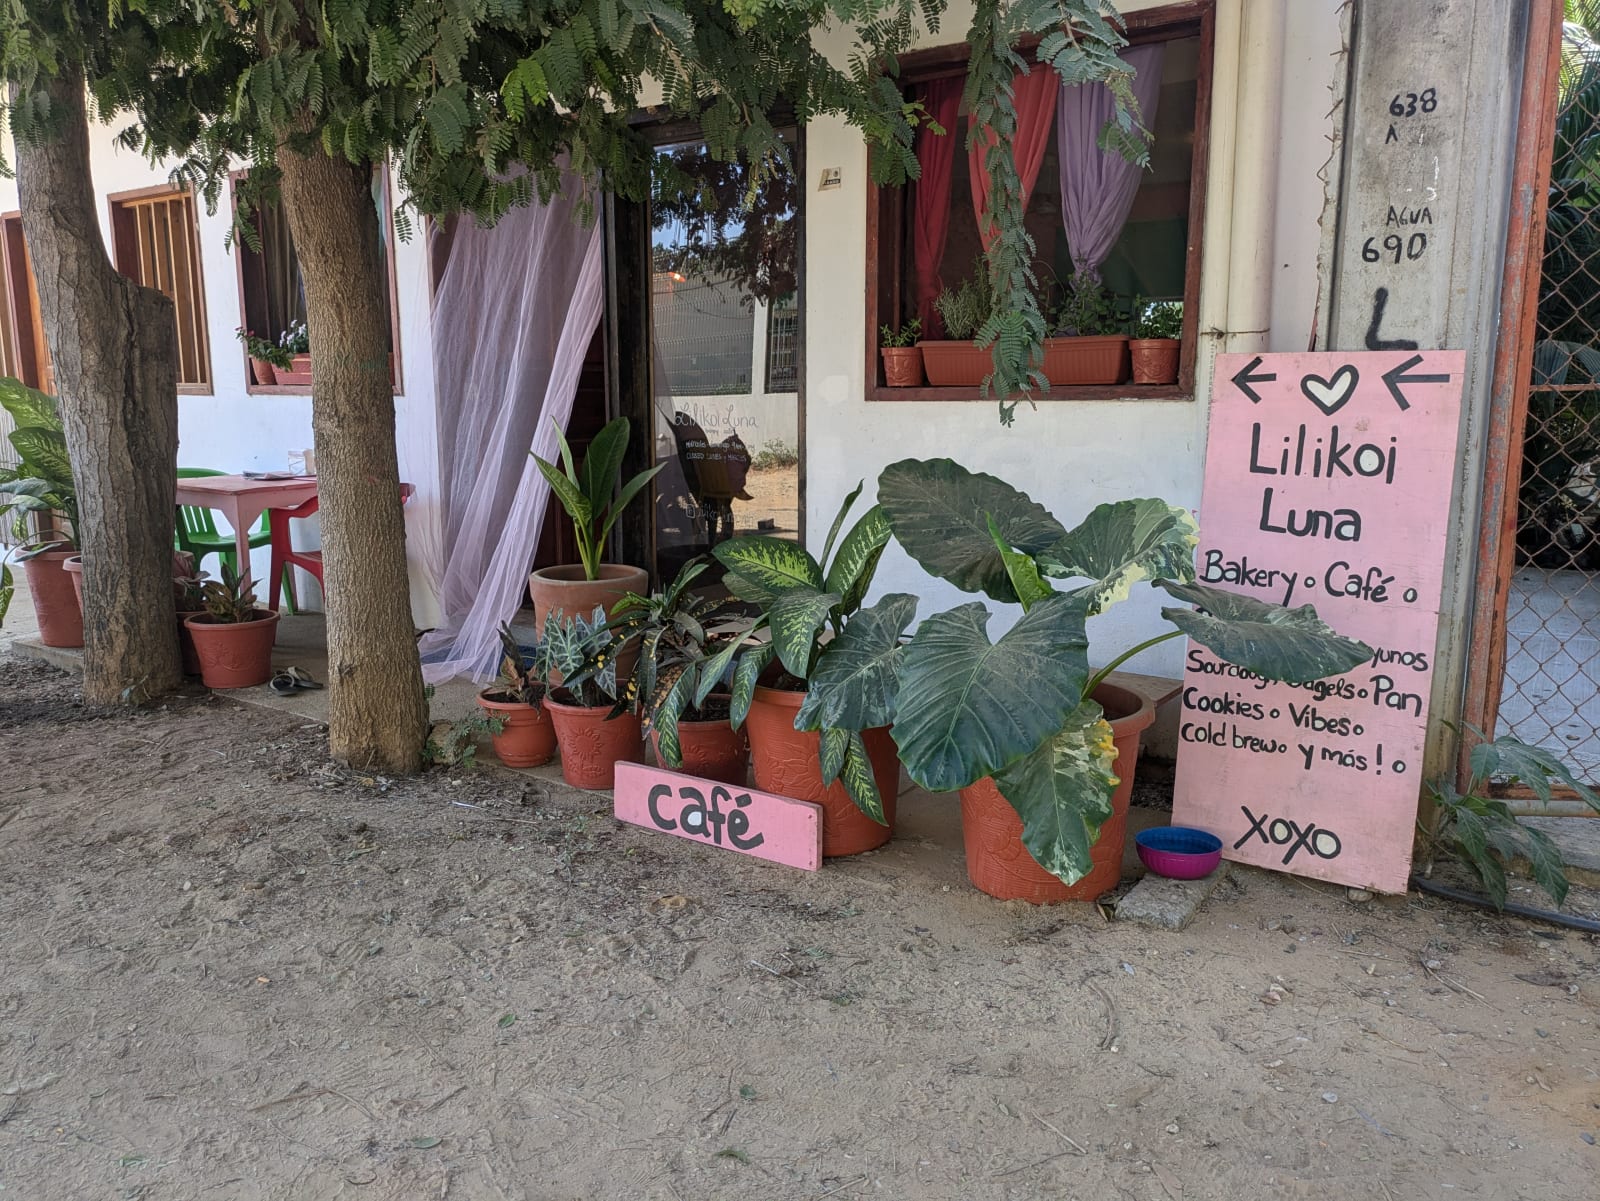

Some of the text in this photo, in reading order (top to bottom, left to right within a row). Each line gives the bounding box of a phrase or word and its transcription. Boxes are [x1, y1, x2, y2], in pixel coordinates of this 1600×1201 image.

[1389, 87, 1438, 118] 638
[1385, 205, 1433, 227] AGUA
[1361, 232, 1428, 265] 690
[1249, 422, 1398, 484] Lilikoi
[1259, 487, 1362, 542] Luna
[1199, 549, 1396, 607] Bakery Café
[1183, 686, 1352, 737] Cookies Vibes
[1286, 677, 1356, 702] agels
[1369, 674, 1423, 718] Pan
[1232, 724, 1277, 754] brew
